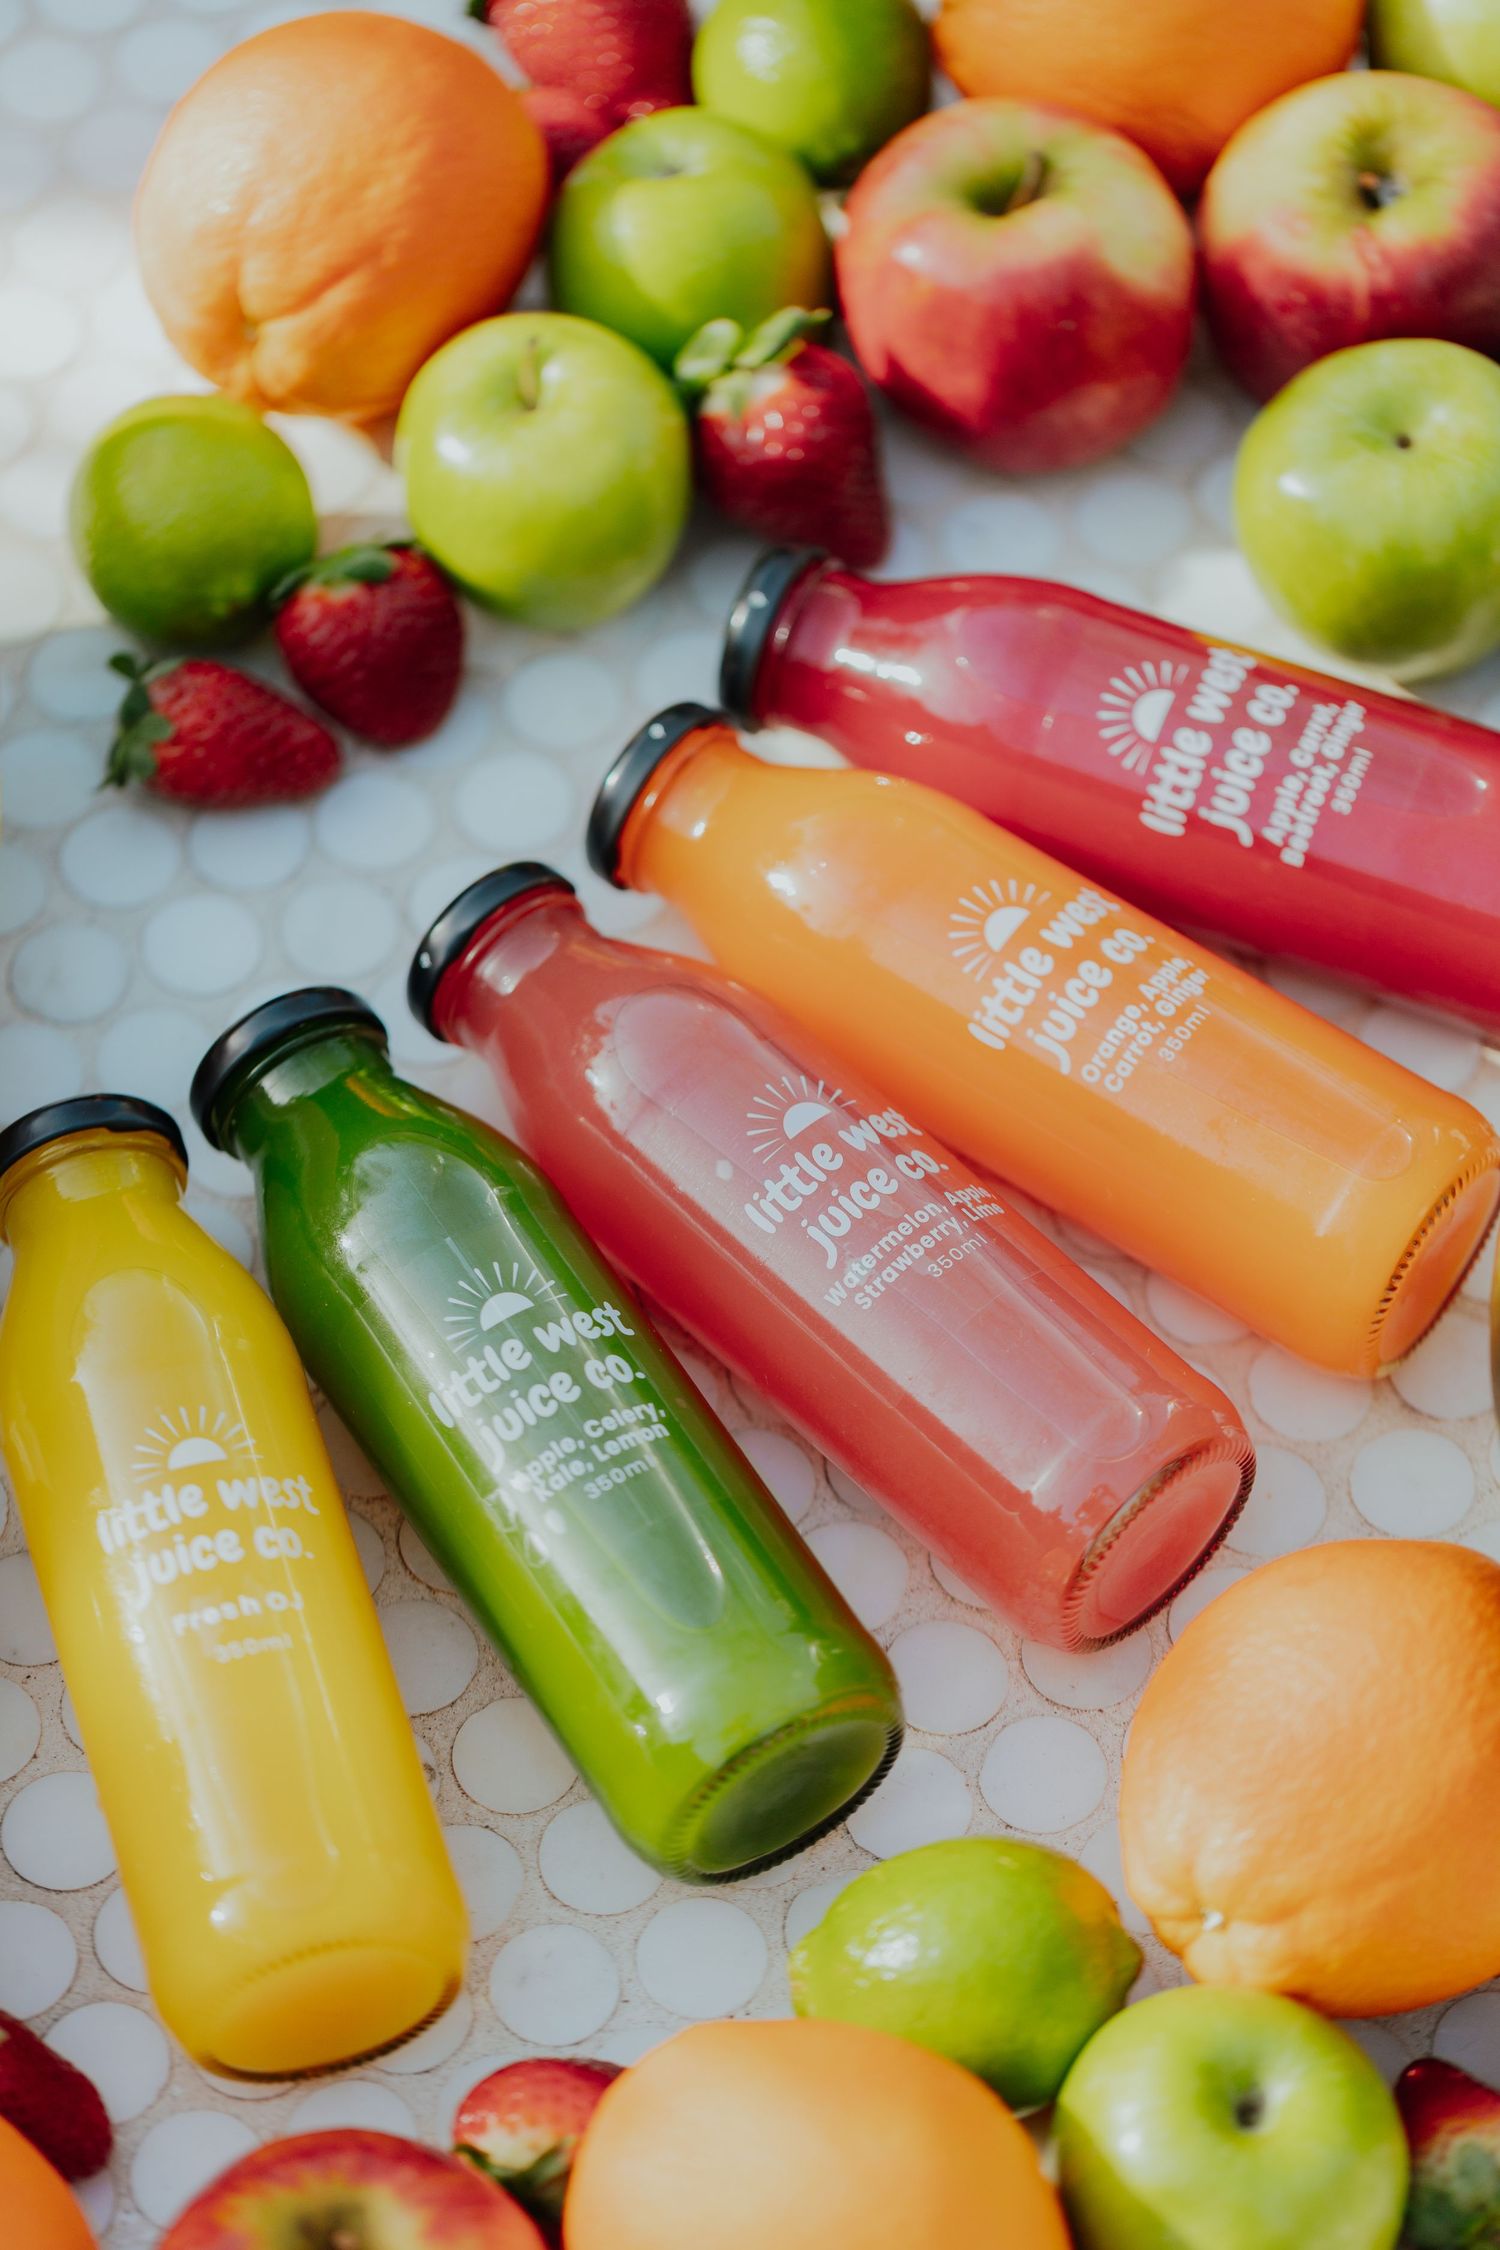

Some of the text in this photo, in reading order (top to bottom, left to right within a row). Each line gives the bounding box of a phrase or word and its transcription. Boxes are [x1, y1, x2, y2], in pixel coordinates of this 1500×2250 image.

[1139, 646, 1257, 837] little west
[1198, 683, 1300, 848] juice co.
[1330, 746, 1374, 816] 350ml
[1261, 771, 1310, 847] Apple,
[967, 886, 1121, 1050] little west
[1026, 928, 1156, 1075] juice co.
[1081, 956, 1194, 1084] Orange, Apple,
[1103, 968, 1211, 1093] Carrot, Ginger
[1158, 1004, 1211, 1062] 350ml
[744, 1107, 923, 1234] little west
[800, 1150, 949, 1270] juice co.
[824, 1202, 949, 1307] Watermelon,
[854, 1203, 1005, 1310] Strawberry, Lime
[927, 1232, 989, 1278] 350ml
[428, 1301, 635, 1428] little west
[476, 1354, 646, 1475] juice co.
[511, 1402, 666, 1490] pple, Celery,
[531, 1423, 670, 1502] Kale, Lemon
[583, 1455, 658, 1500] 350ml
[95, 1475, 320, 1555] little west
[128, 1526, 315, 1613] juice co.
